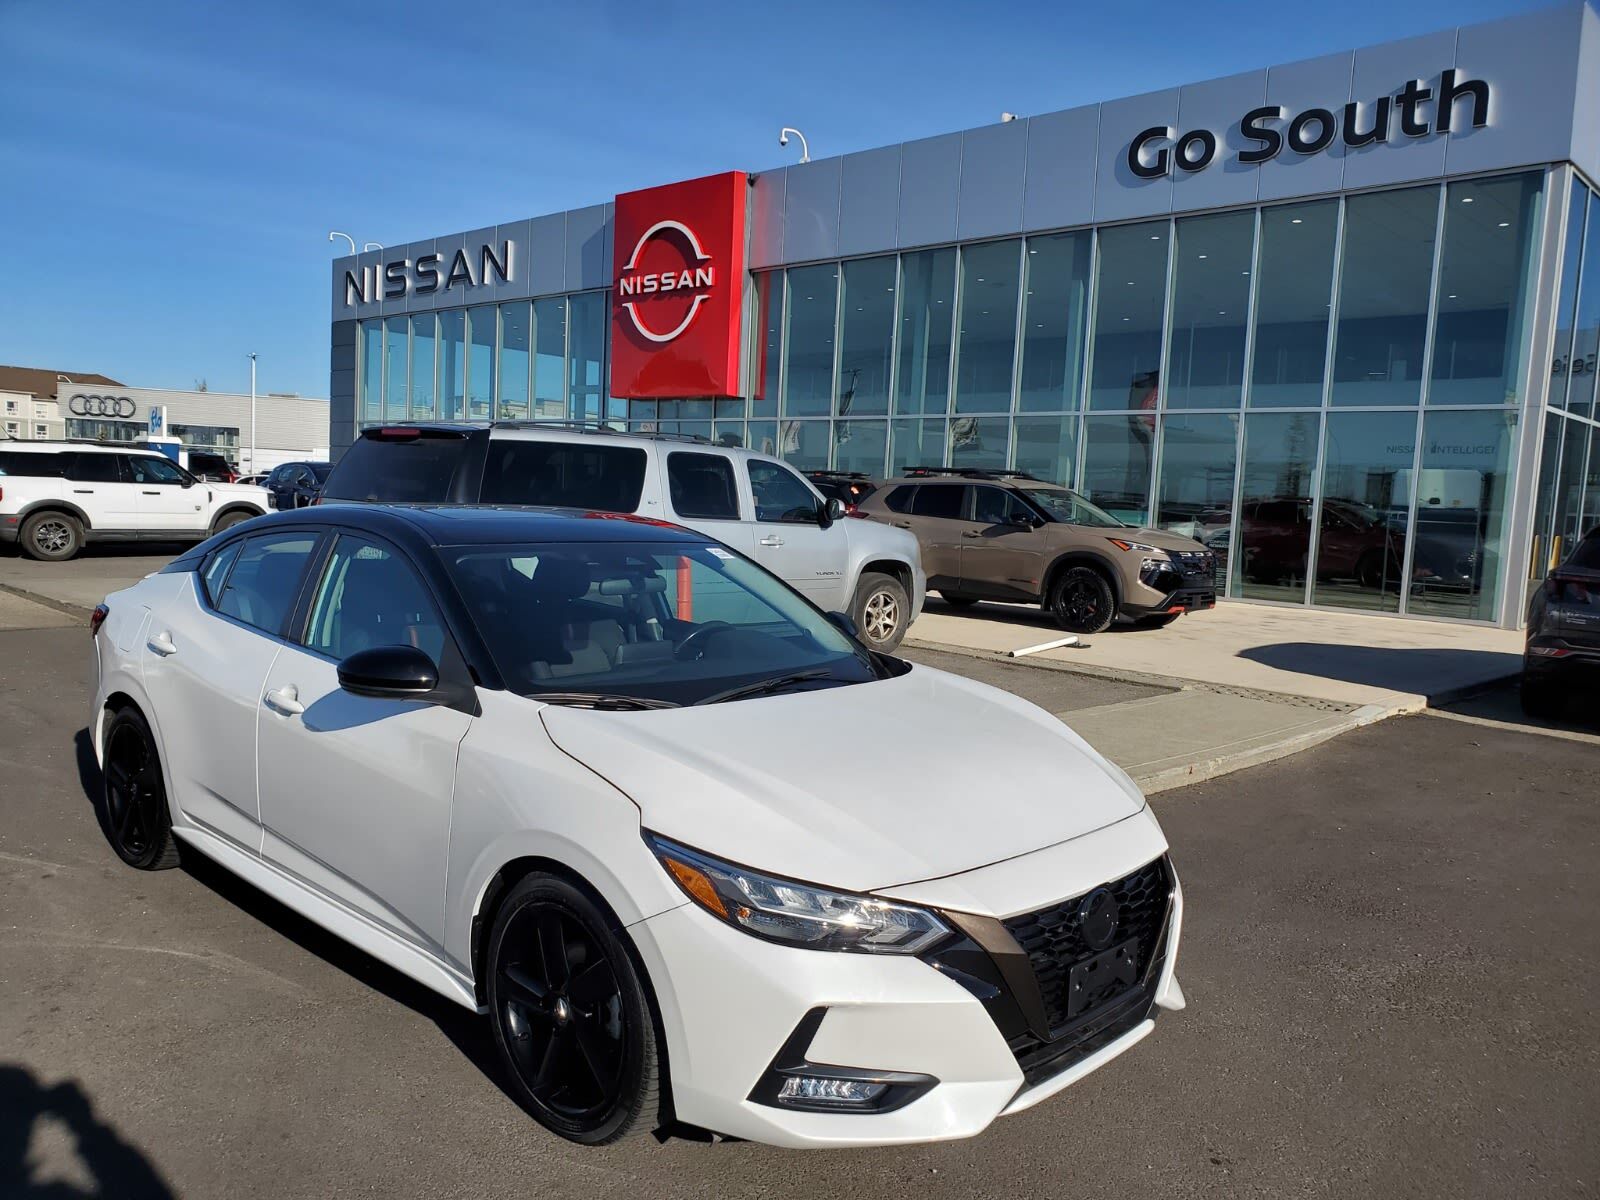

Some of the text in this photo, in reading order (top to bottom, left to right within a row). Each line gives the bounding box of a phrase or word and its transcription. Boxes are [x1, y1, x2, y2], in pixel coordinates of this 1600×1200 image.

[1127, 69, 1490, 179] Go South
[345, 240, 512, 305] NISSAN
[620, 267, 715, 296] NISSAN
